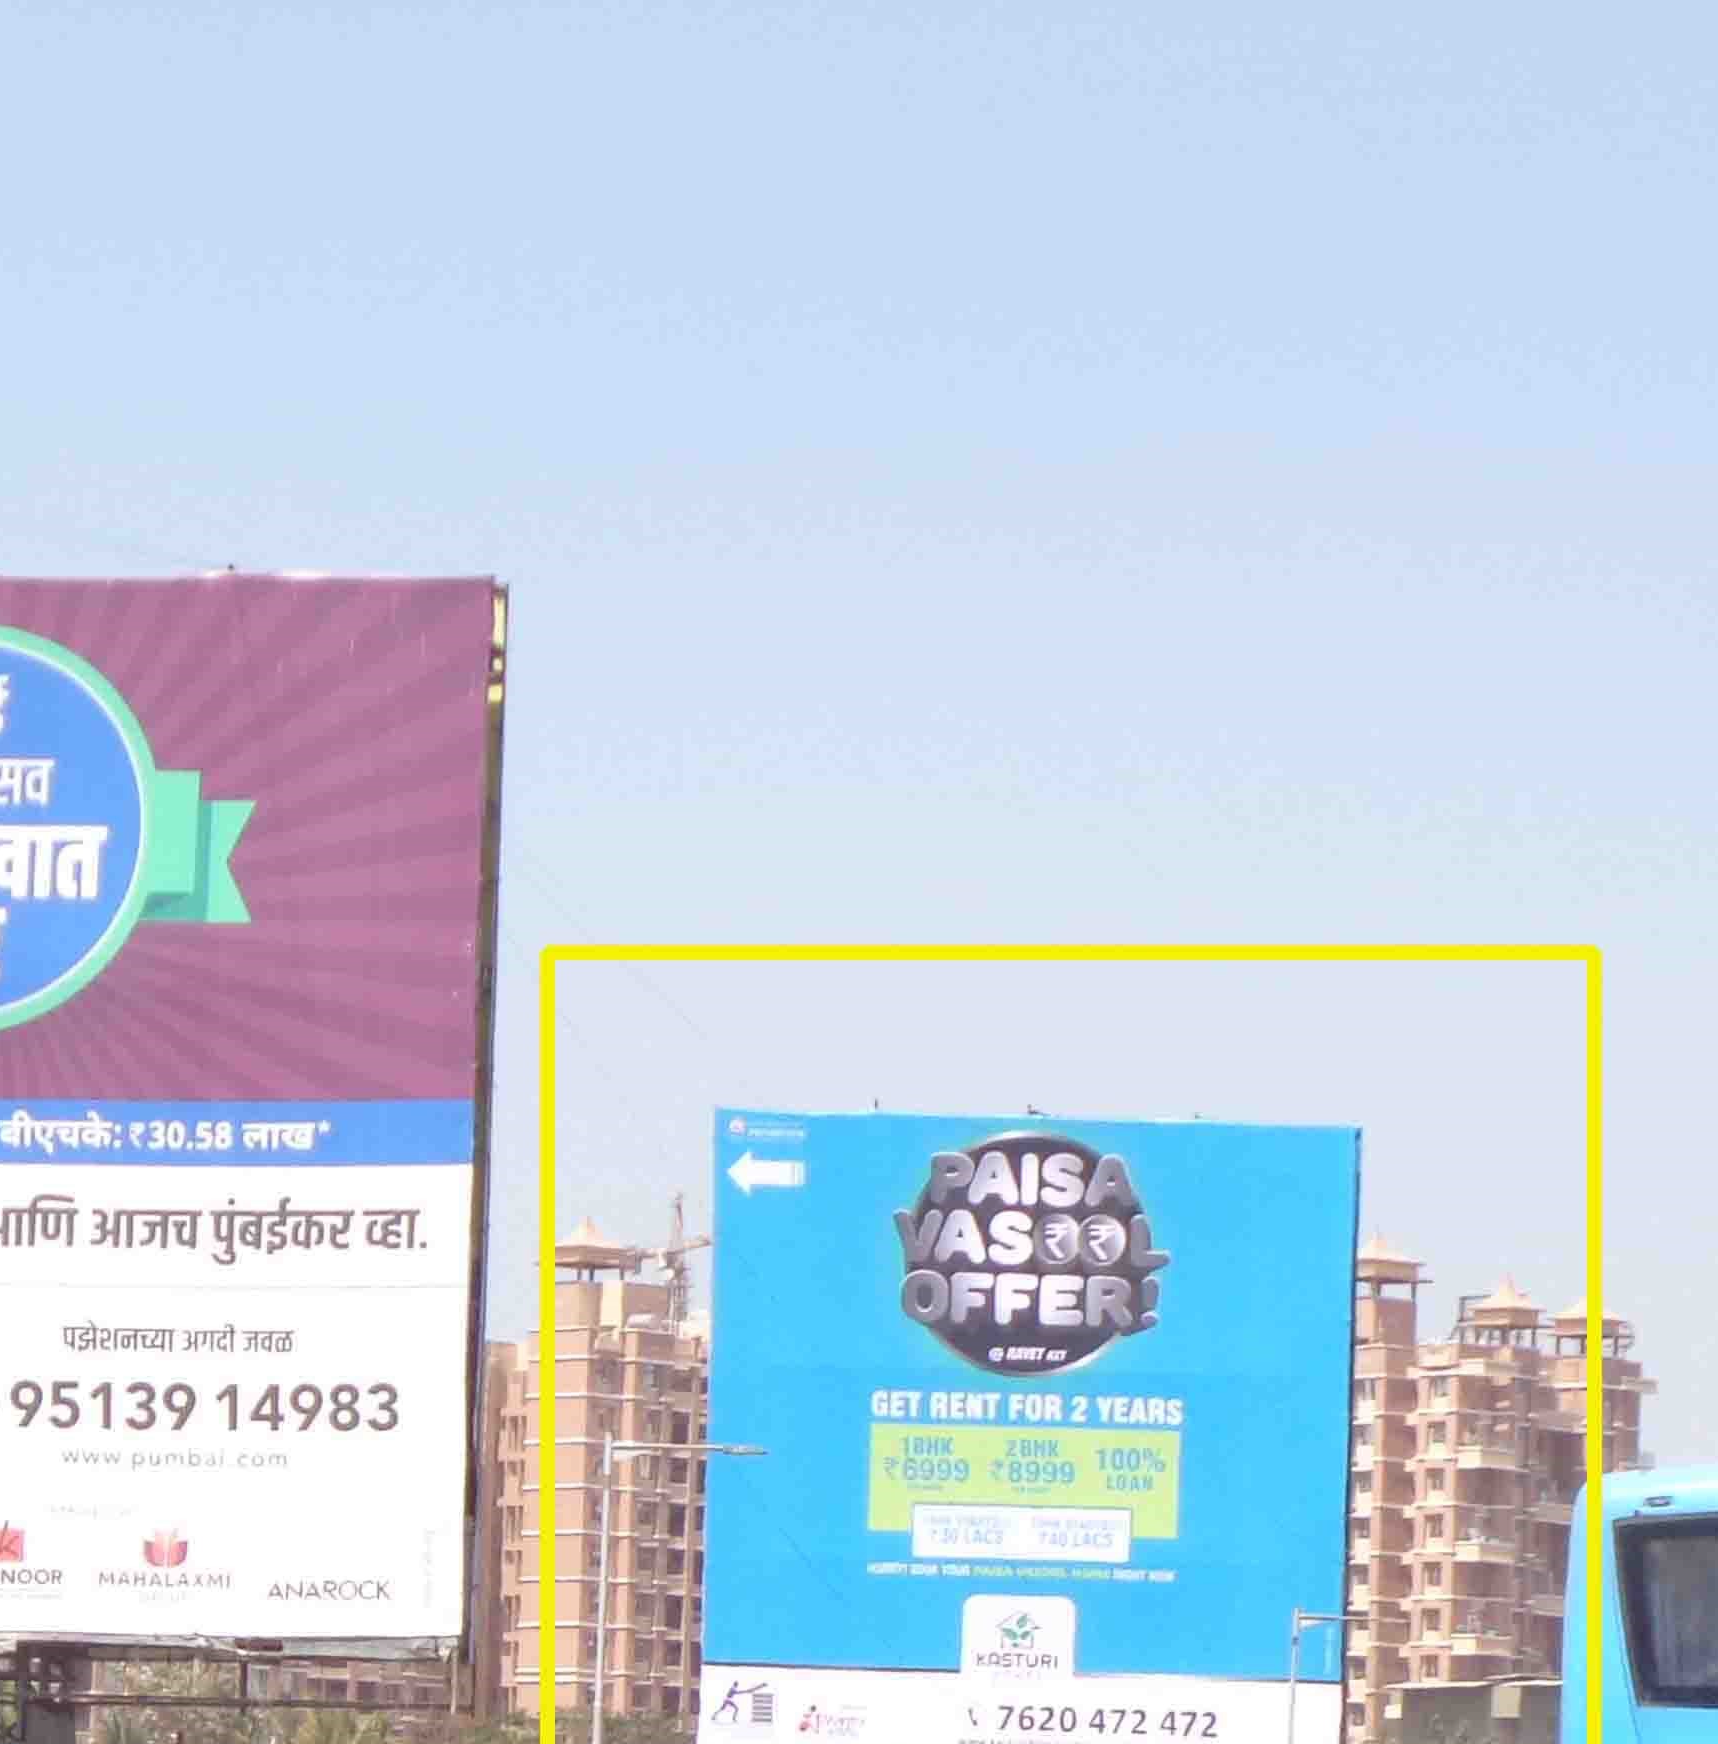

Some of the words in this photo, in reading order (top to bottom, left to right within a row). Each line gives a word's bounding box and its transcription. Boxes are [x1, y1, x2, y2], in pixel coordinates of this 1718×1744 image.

[129, 1120, 233, 1151] ₹30.58
[930, 1151, 1136, 1208] PAISA
[89, 1207, 203, 1251] आजच
[209, 1196, 356, 1266] पुंबईकर
[901, 1269, 1161, 1329] OFFER!
[242, 1328, 296, 1354] जवळ
[9, 1379, 197, 1432] 95139
[215, 1382, 400, 1433] 14983
[871, 1390, 921, 1418] GET
[928, 1391, 1000, 1421] RENT
[1008, 1393, 1063, 1422] FOR
[1071, 1396, 1090, 1423] 2
[1096, 1397, 1184, 1426] YEARS
[1005, 1439, 1059, 1459] 2BHK
[1095, 1447, 1167, 1474] 100%
[97, 1570, 233, 1590] MAHALAXMI
[266, 1579, 393, 1602] ANAROCK
[976, 1652, 1059, 1669] KASTURI
[998, 1705, 1077, 1733] 7620
[1088, 1708, 1148, 1735] 472
[1159, 1711, 1219, 1738] 472
